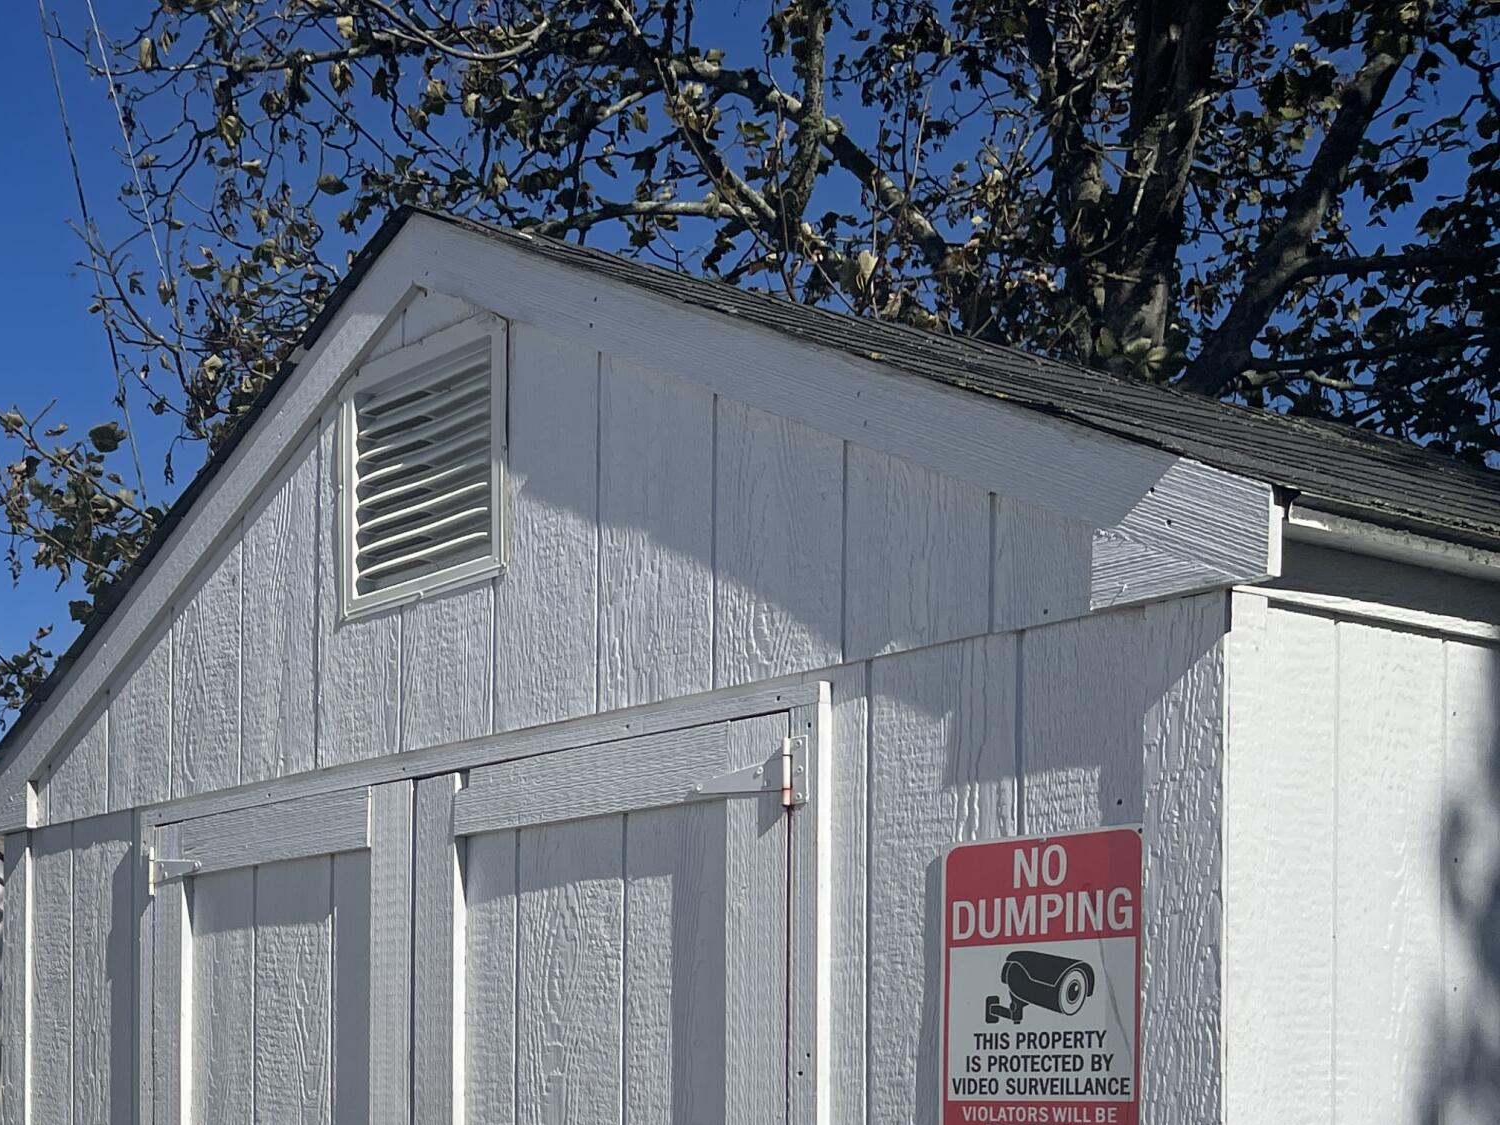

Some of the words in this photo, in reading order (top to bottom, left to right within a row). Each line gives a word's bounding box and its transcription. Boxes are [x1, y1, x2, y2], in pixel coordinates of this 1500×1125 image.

[1013, 844, 1068, 889] NO
[952, 887, 1133, 940] DUMPING
[974, 1032, 1010, 1051] THIS
[1016, 1030, 1107, 1049] PROPERTY
[966, 1056, 982, 1073] IS
[987, 1054, 1084, 1073] PROTECTED
[1091, 1054, 1114, 1072] BY
[952, 1078, 999, 1096] VIDEO
[1006, 1077, 1131, 1096] SURVEILLANCE
[962, 1106, 1049, 1123] VIOLATORS
[1052, 1107, 1091, 1123] WILL
[1095, 1107, 1117, 1123] BE
